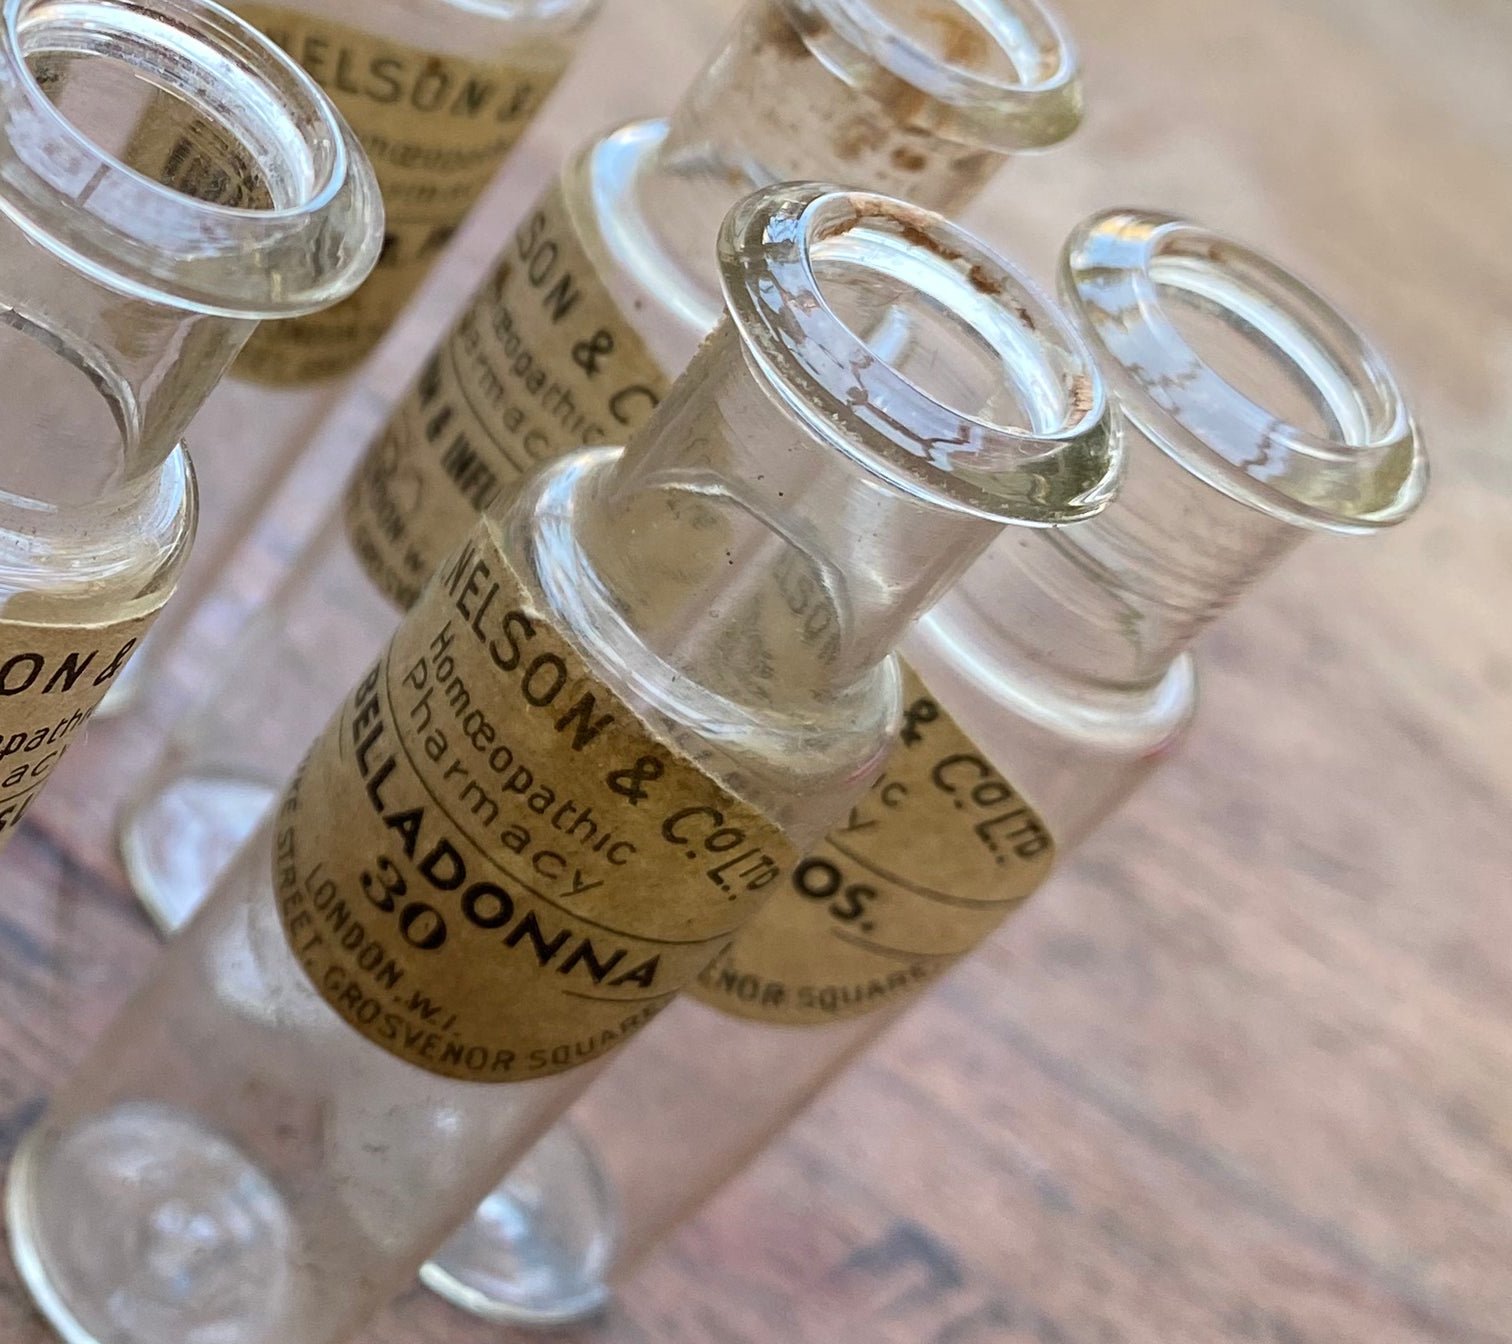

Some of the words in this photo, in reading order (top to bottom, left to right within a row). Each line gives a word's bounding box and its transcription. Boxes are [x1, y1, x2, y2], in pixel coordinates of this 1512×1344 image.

[516, 212, 582, 324] SON
[572, 328, 615, 377] &
[92, 636, 138, 687] &
[900, 698, 939, 749] &
[352, 662, 661, 990] BELLADONNA
[402, 656, 605, 900] Pharmacy
[606, 755, 666, 806] &
[360, 853, 448, 951] 30
[791, 858, 878, 933] OS.
[323, 964, 516, 1072] GROSVENOR
